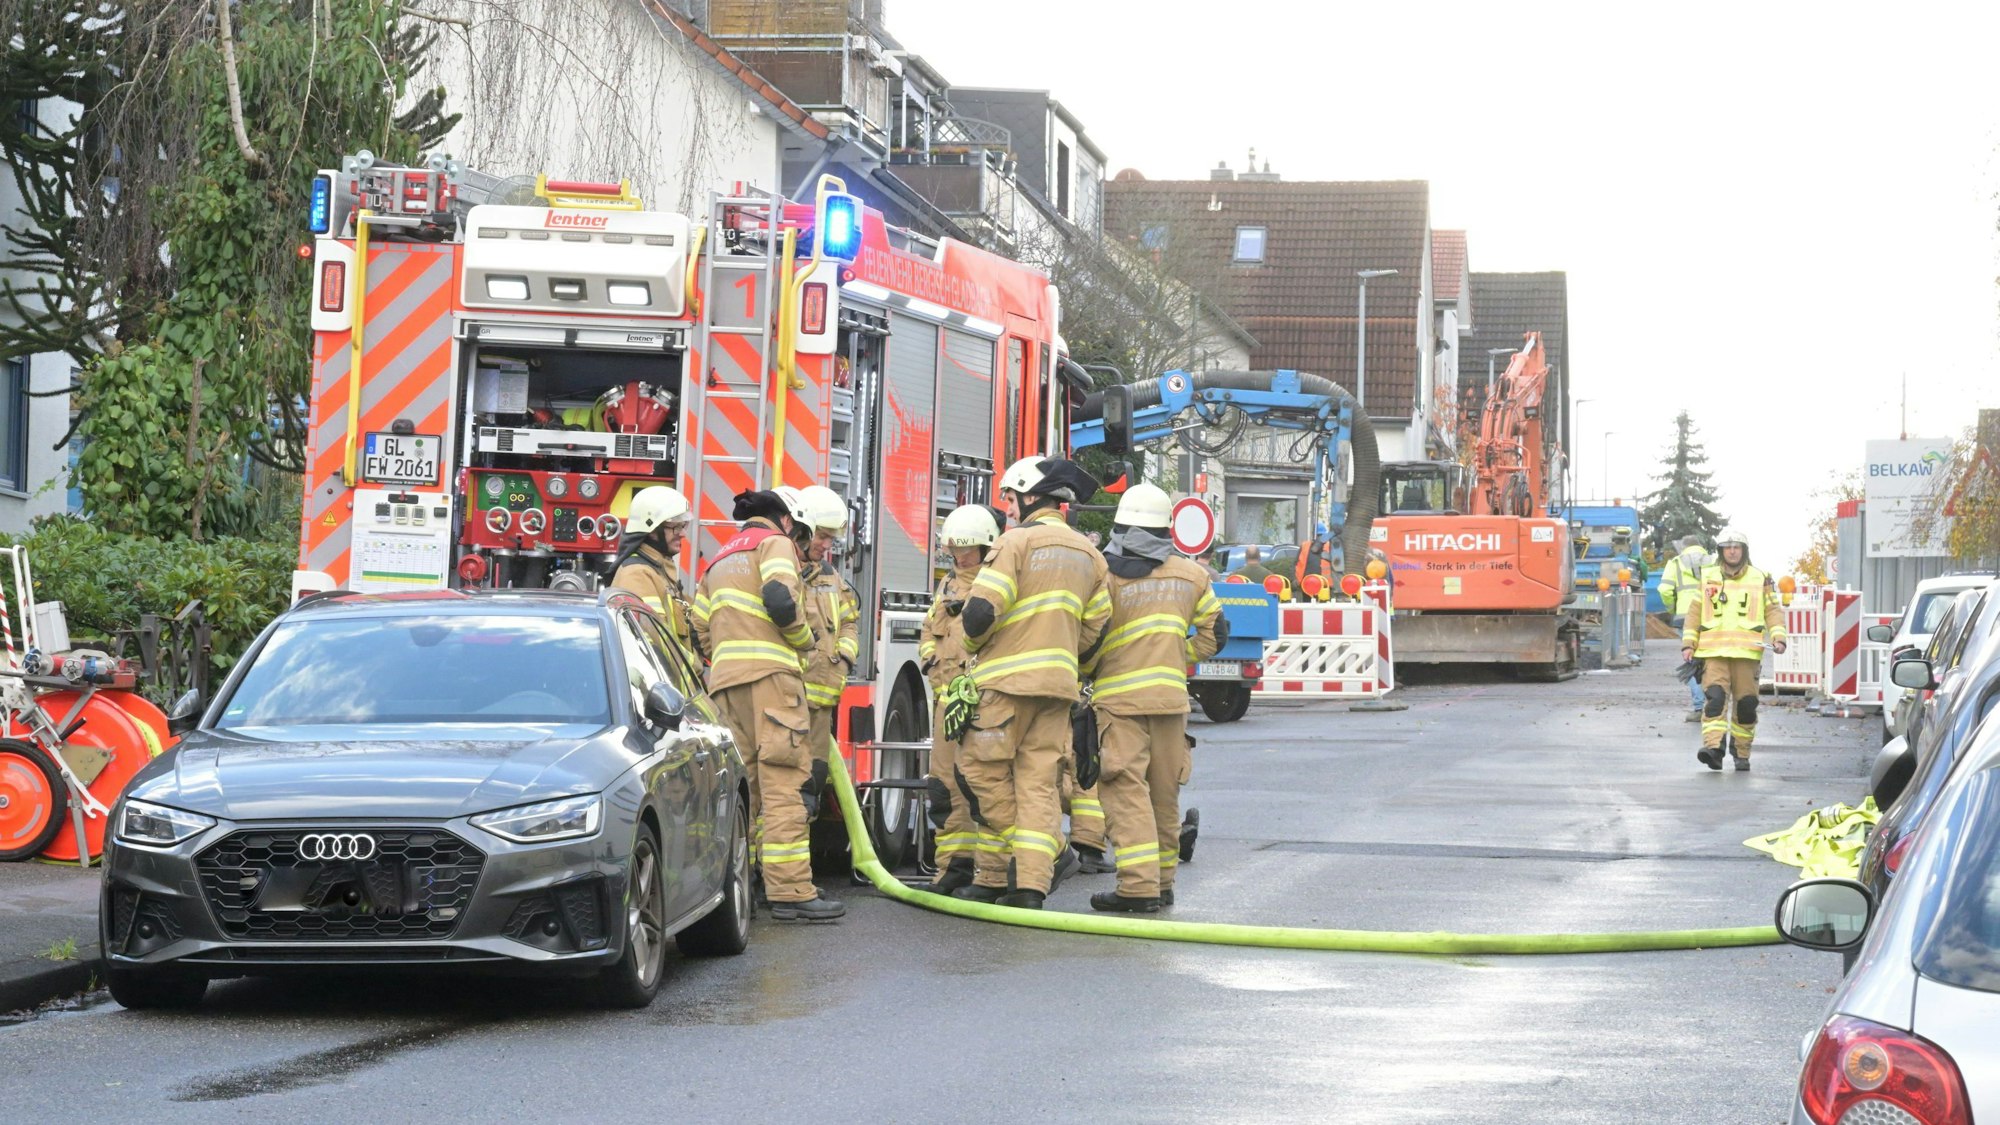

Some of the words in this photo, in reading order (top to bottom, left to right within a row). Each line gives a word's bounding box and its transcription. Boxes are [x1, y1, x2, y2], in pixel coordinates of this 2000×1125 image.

[544, 210, 608, 228] Lentner
[735, 272, 756, 319] 1
[626, 333, 654, 342] Lentner
[384, 438, 405, 457] GL
[367, 456, 389, 476] FW
[394, 458, 434, 478] 2061
[1869, 463, 1933, 477] BELKAW
[1404, 534, 1501, 551] HITACHI
[1426, 561, 1453, 571] Stark
[1456, 562, 1466, 571] in
[1490, 561, 1513, 571] Tiefe
